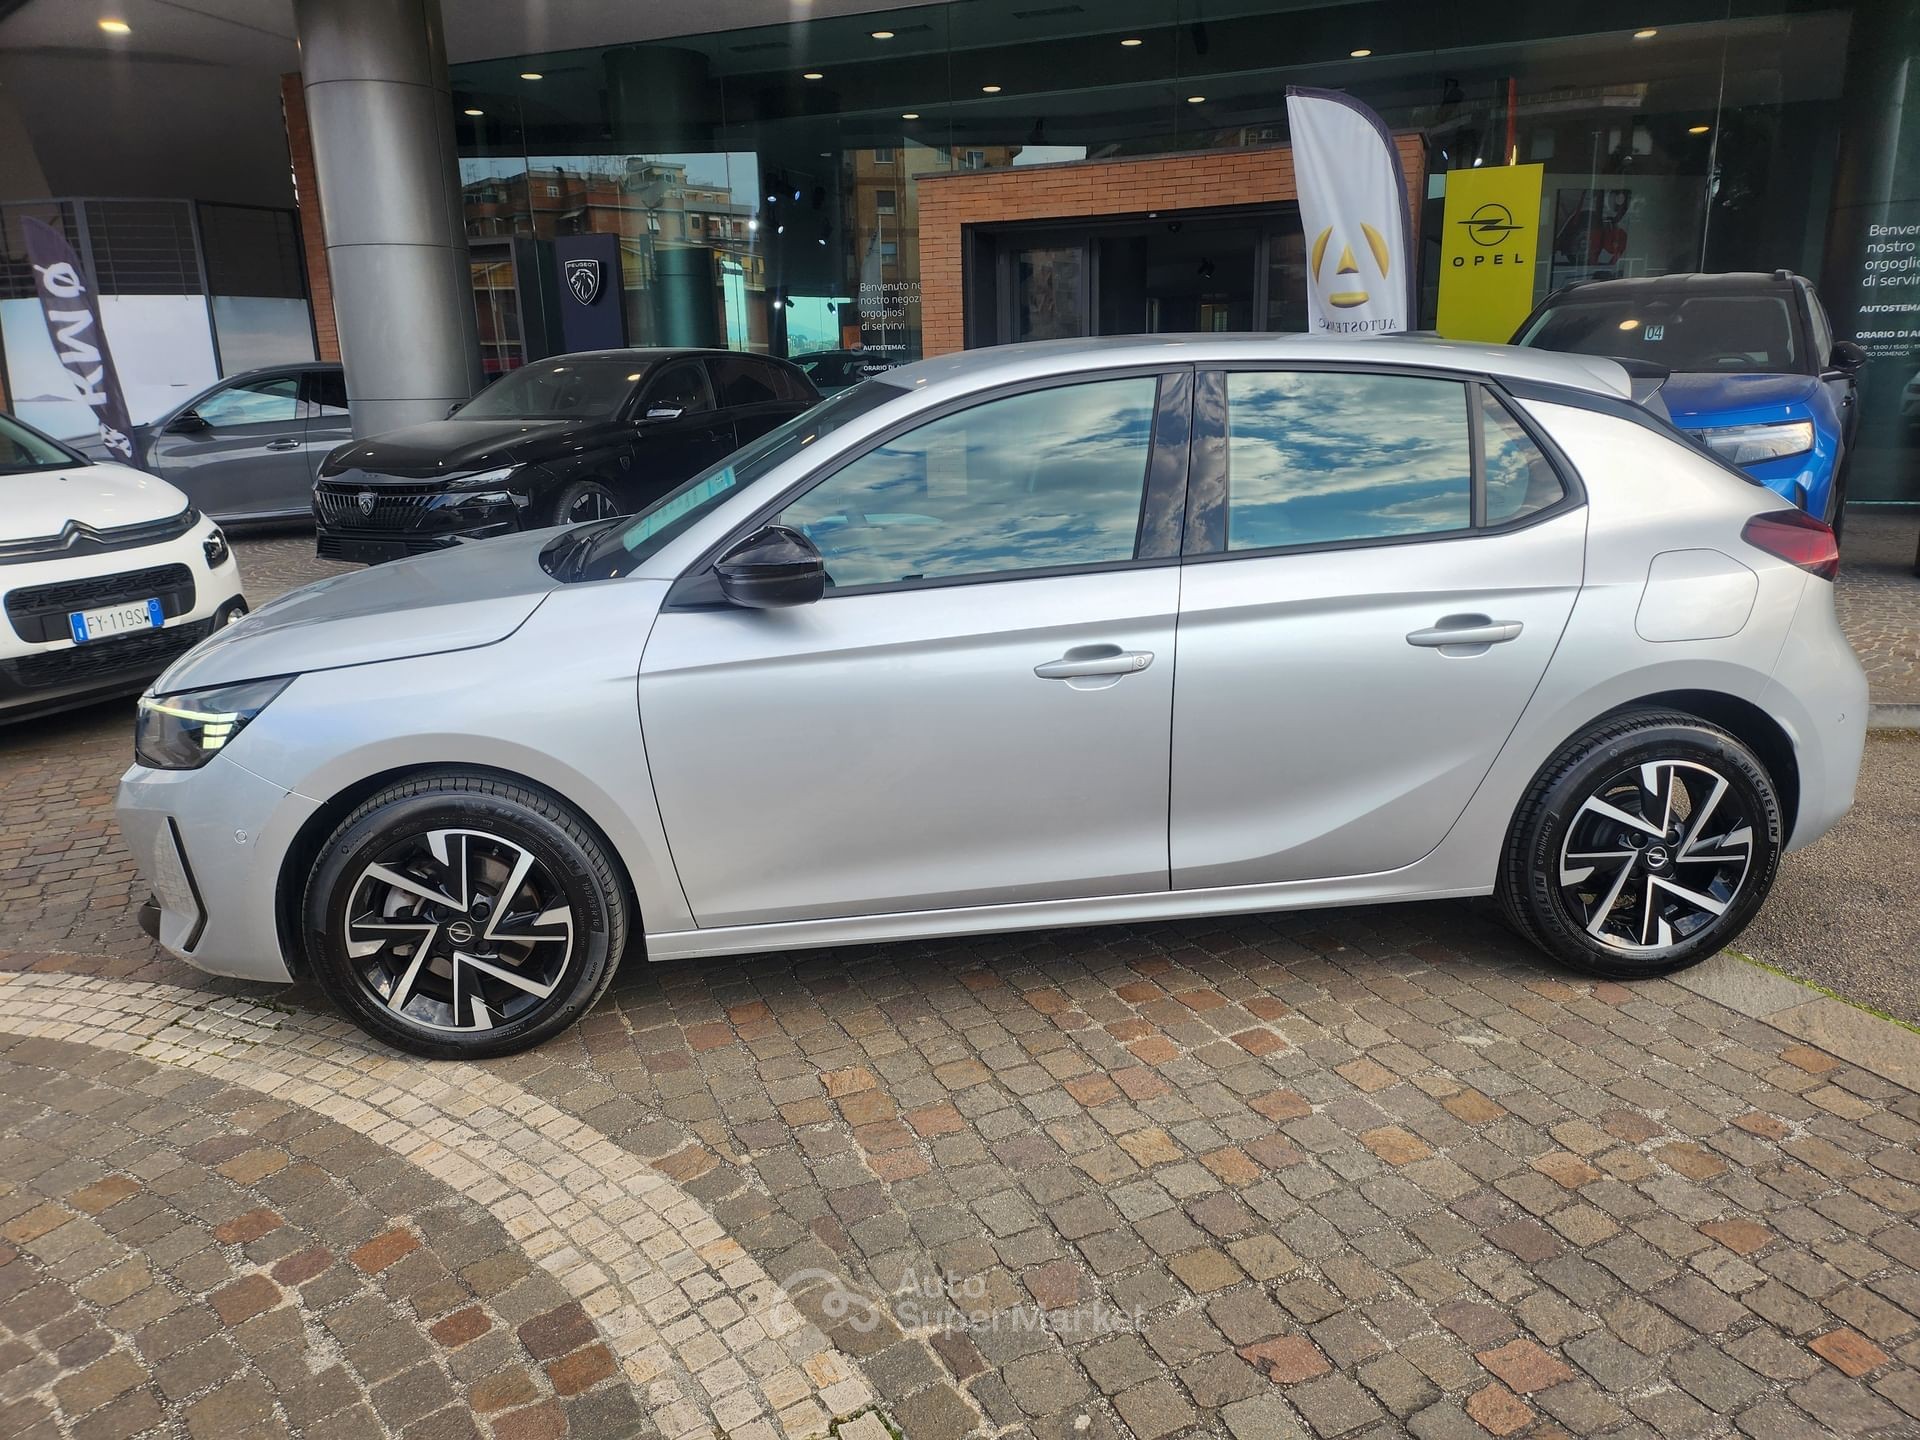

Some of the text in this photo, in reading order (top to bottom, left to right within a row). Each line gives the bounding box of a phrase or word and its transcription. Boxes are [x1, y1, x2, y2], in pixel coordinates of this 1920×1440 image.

[1867, 240, 1915, 253] nostro
[1453, 253, 1524, 267] OPEL
[860, 281, 921, 292] Benvenuto ne
[1862, 274, 1877, 287] di
[860, 295, 922, 305] nostro negozi
[860, 307, 905, 319] orgogliosi
[861, 321, 905, 331] di servirvi
[1647, 326, 1662, 340] 04
[1855, 331, 1895, 339] ORARIO
[1897, 330, 1908, 338] DI
[1741, 761, 1778, 837] MICHELIN
